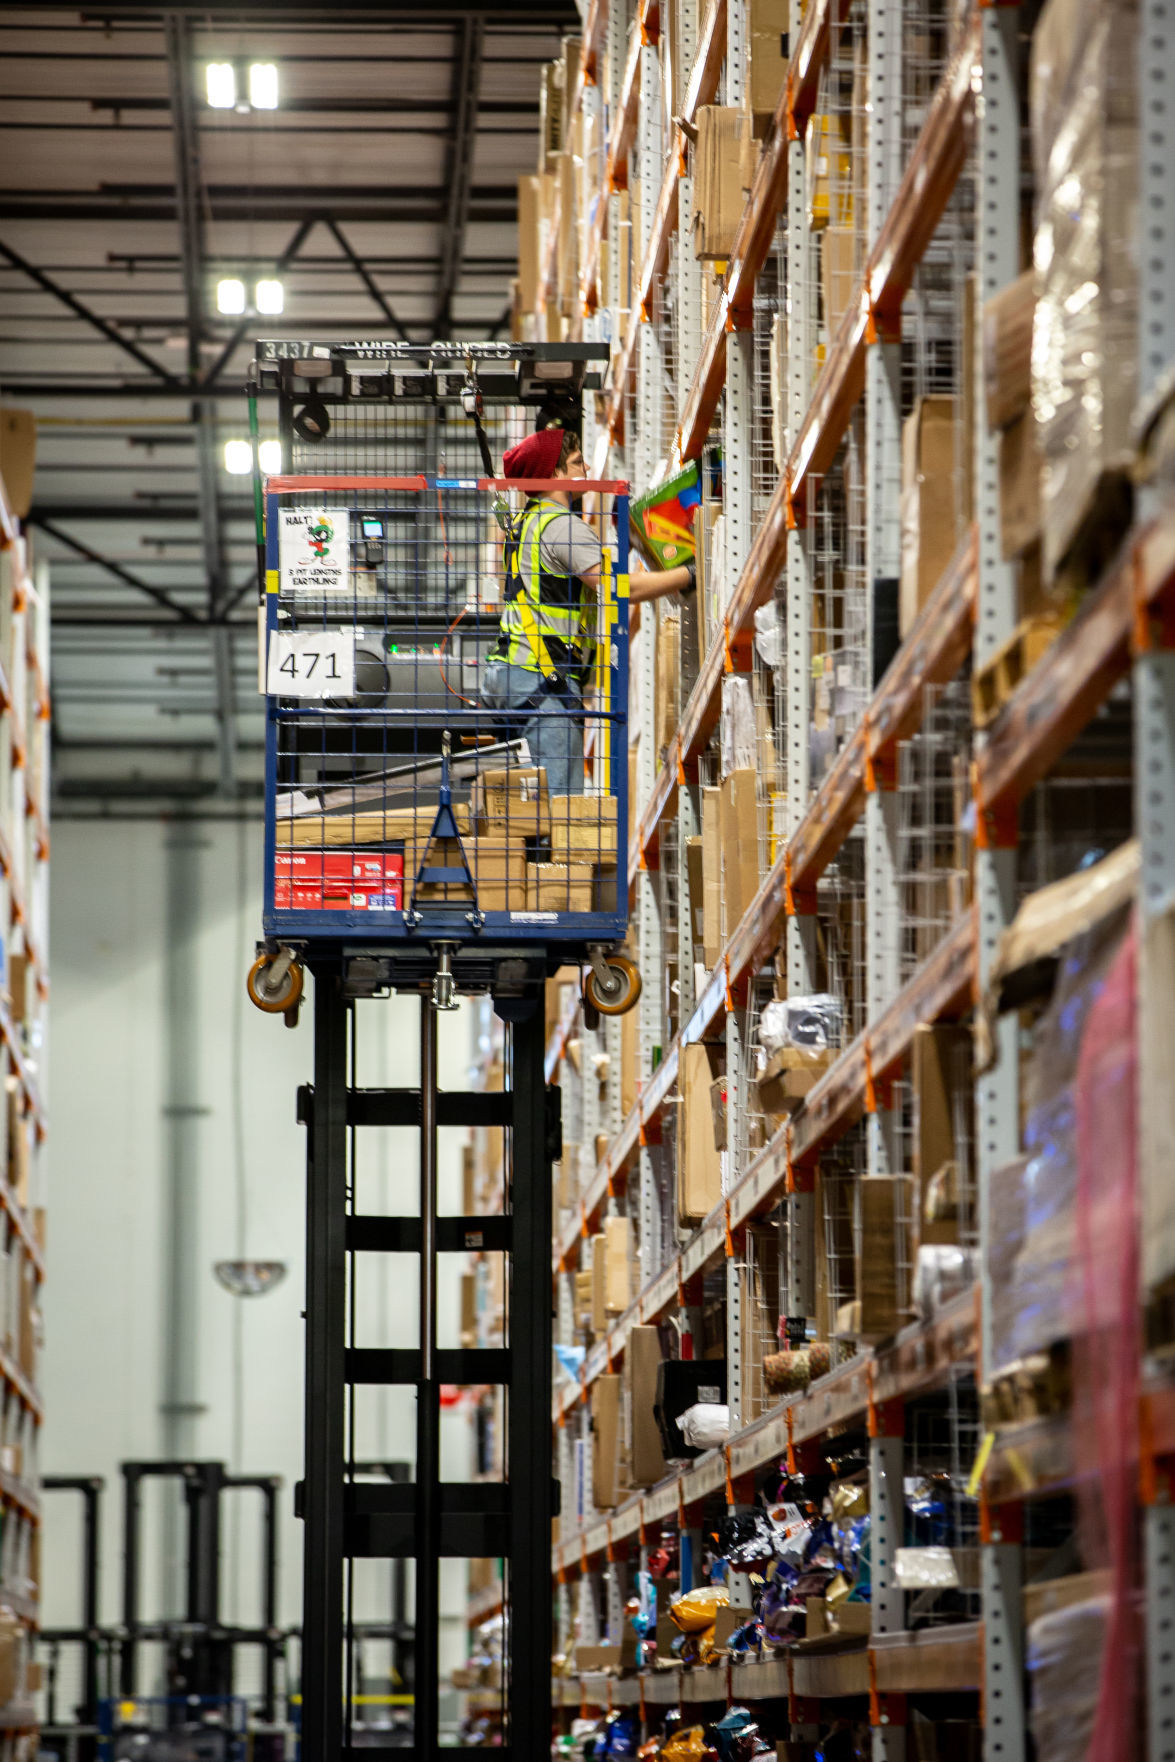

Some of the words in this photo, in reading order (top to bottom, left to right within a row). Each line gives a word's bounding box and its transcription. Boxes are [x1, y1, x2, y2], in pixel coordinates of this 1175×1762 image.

[266, 342, 310, 358] 3437
[354, 341, 410, 358] WIRE
[280, 653, 341, 679] 471
[275, 855, 306, 864] Canon
